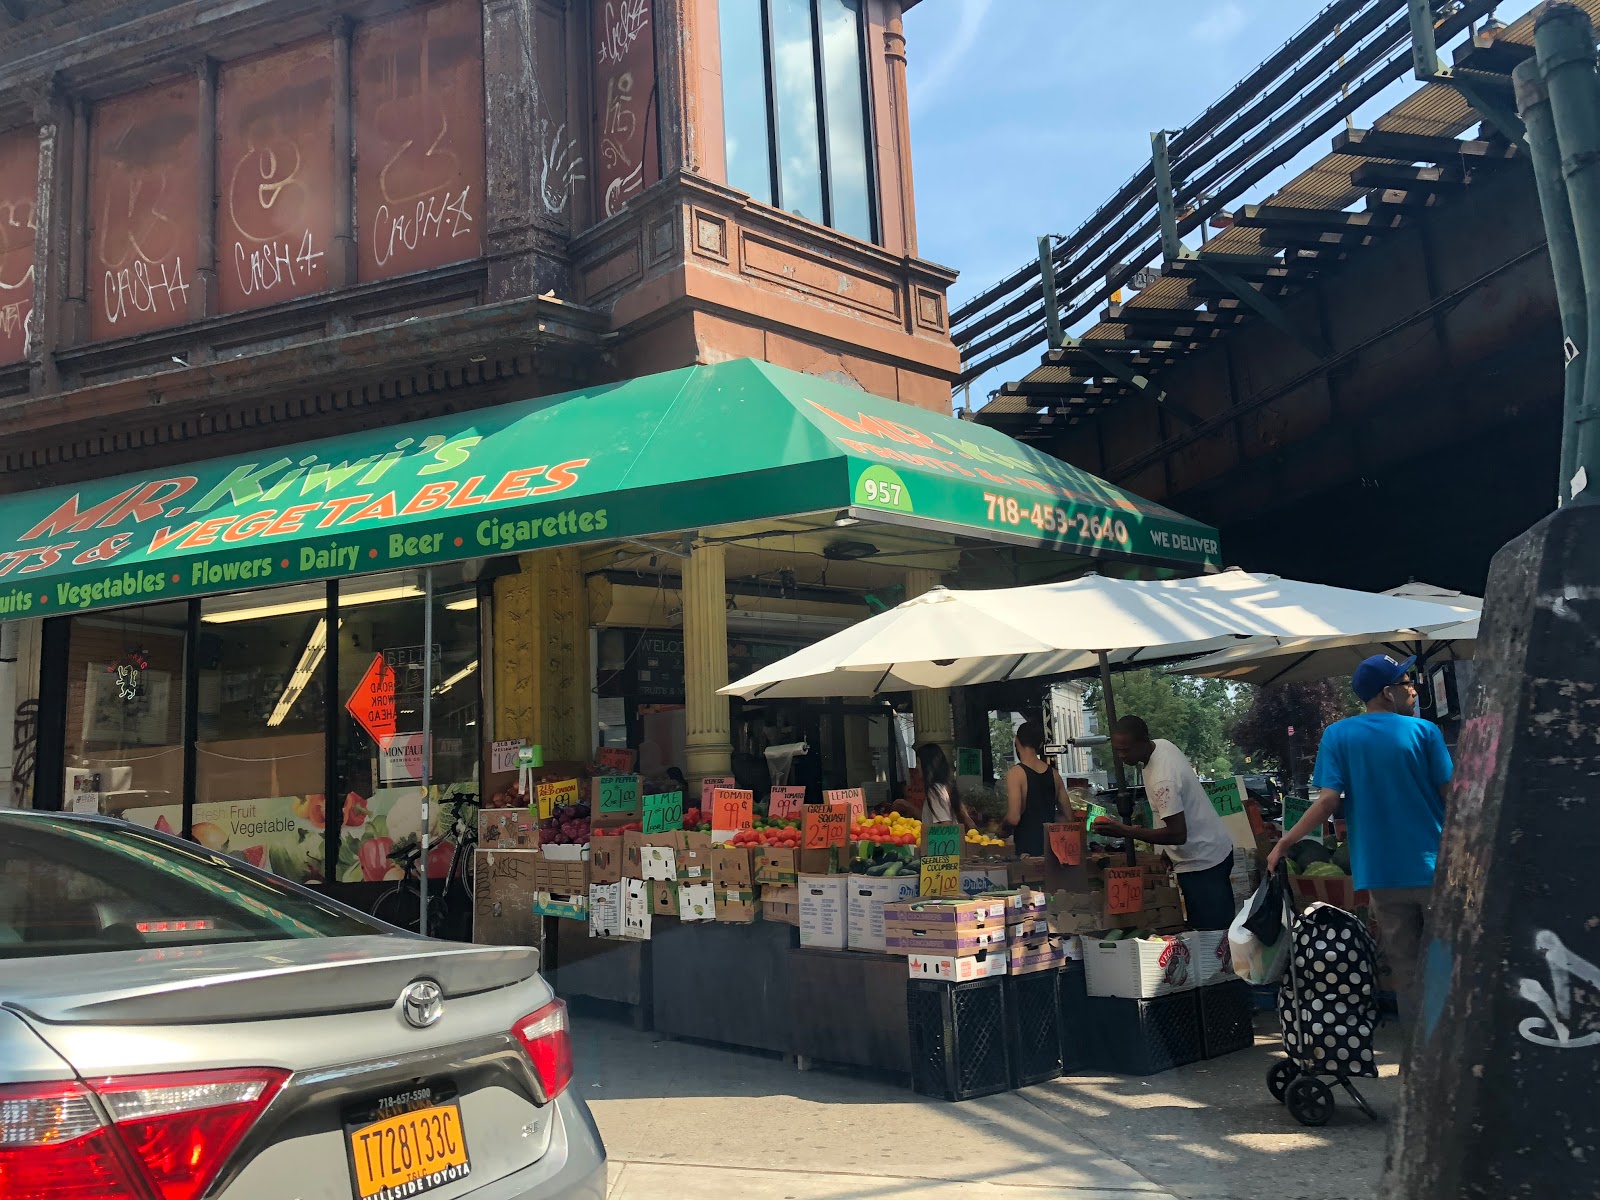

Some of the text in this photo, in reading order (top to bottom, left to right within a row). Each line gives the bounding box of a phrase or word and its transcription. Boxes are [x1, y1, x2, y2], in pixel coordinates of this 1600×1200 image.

[17, 434, 483, 541] MR. Kiwi's
[864, 479, 902, 505] 957
[72, 532, 134, 565] &
[146, 458, 590, 555] VEGETABLES
[983, 492, 1129, 545] 718-453-2640
[1150, 529, 1219, 556] WE DELIVER
[57, 571, 165, 608] Vegetables
[191, 557, 272, 587] Flowers
[300, 542, 360, 571] Dairy
[389, 533, 444, 559] Beer
[476, 509, 607, 551] Cigarettes
[639, 639, 685, 653] WELCO
[719, 791, 752, 800] TOMATO
[831, 789, 859, 801] LEMON
[1206, 783, 1237, 796] TOMATO
[643, 793, 680, 807] LIME
[195, 804, 257, 821] Fresh Fruit
[807, 805, 833, 814] GREEN
[818, 813, 846, 823] SQUASH
[230, 817, 296, 838] Vegetable
[898, 884, 919, 898] Dut
[963, 876, 988, 890] Dutch
[907, 912, 942, 921] CUCUMBERS
[378, 1087, 431, 1109] 718-657-5500
[360, 1112, 456, 1181] T728133C
[362, 1163, 470, 1200] ILLSIDE TOYOTA
